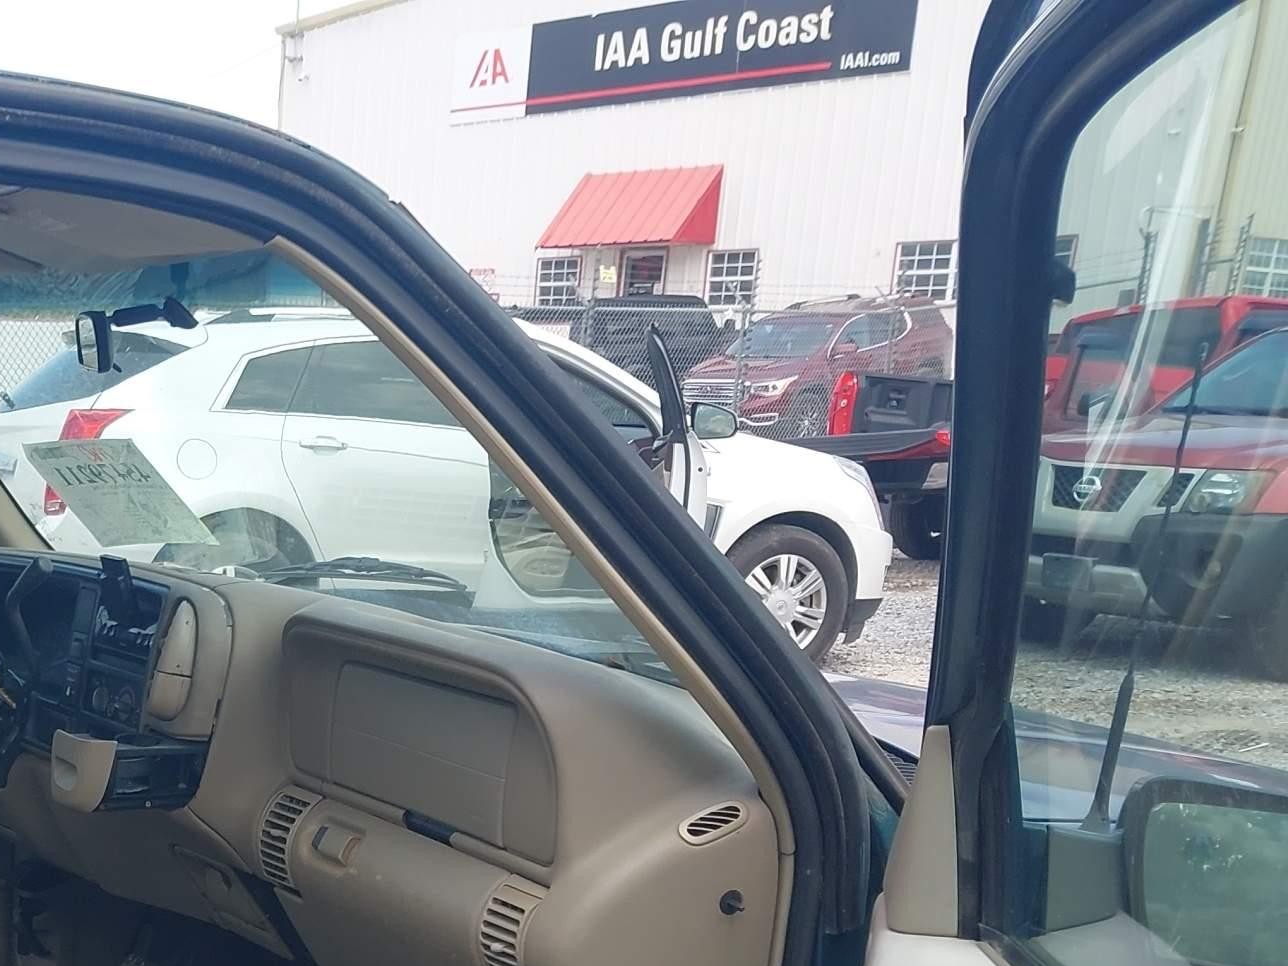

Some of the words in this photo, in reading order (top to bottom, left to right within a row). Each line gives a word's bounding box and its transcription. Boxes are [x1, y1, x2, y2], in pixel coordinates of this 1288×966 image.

[593, 27, 650, 71] IAA
[660, 16, 728, 62] Gulf
[735, 4, 835, 52] Coast
[840, 50, 901, 71] IAAI.com
